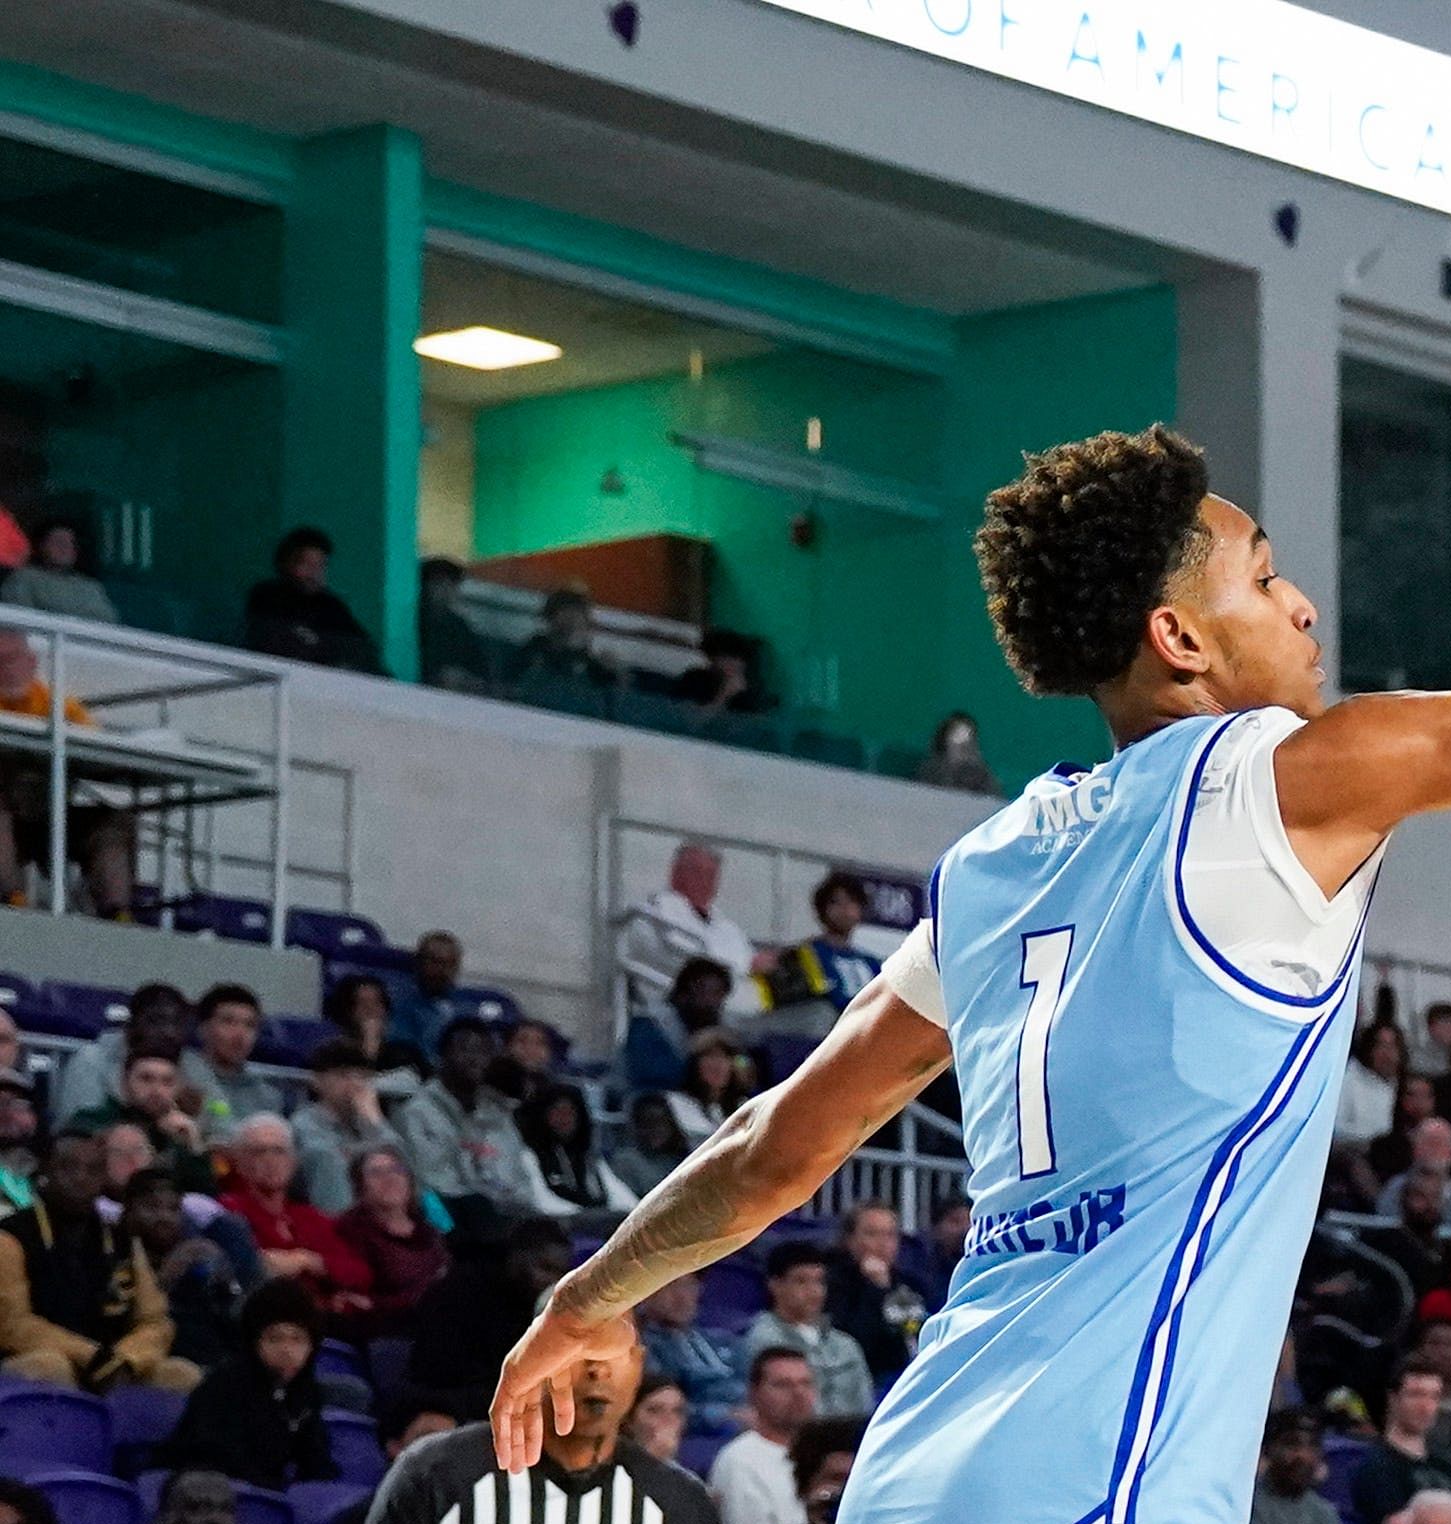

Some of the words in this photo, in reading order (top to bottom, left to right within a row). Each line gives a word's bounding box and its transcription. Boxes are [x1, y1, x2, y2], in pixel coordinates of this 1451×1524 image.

[1065, 12, 1446, 178] AMERICA
[1019, 776, 1113, 837] IMG
[1016, 923, 1076, 1181] 1
